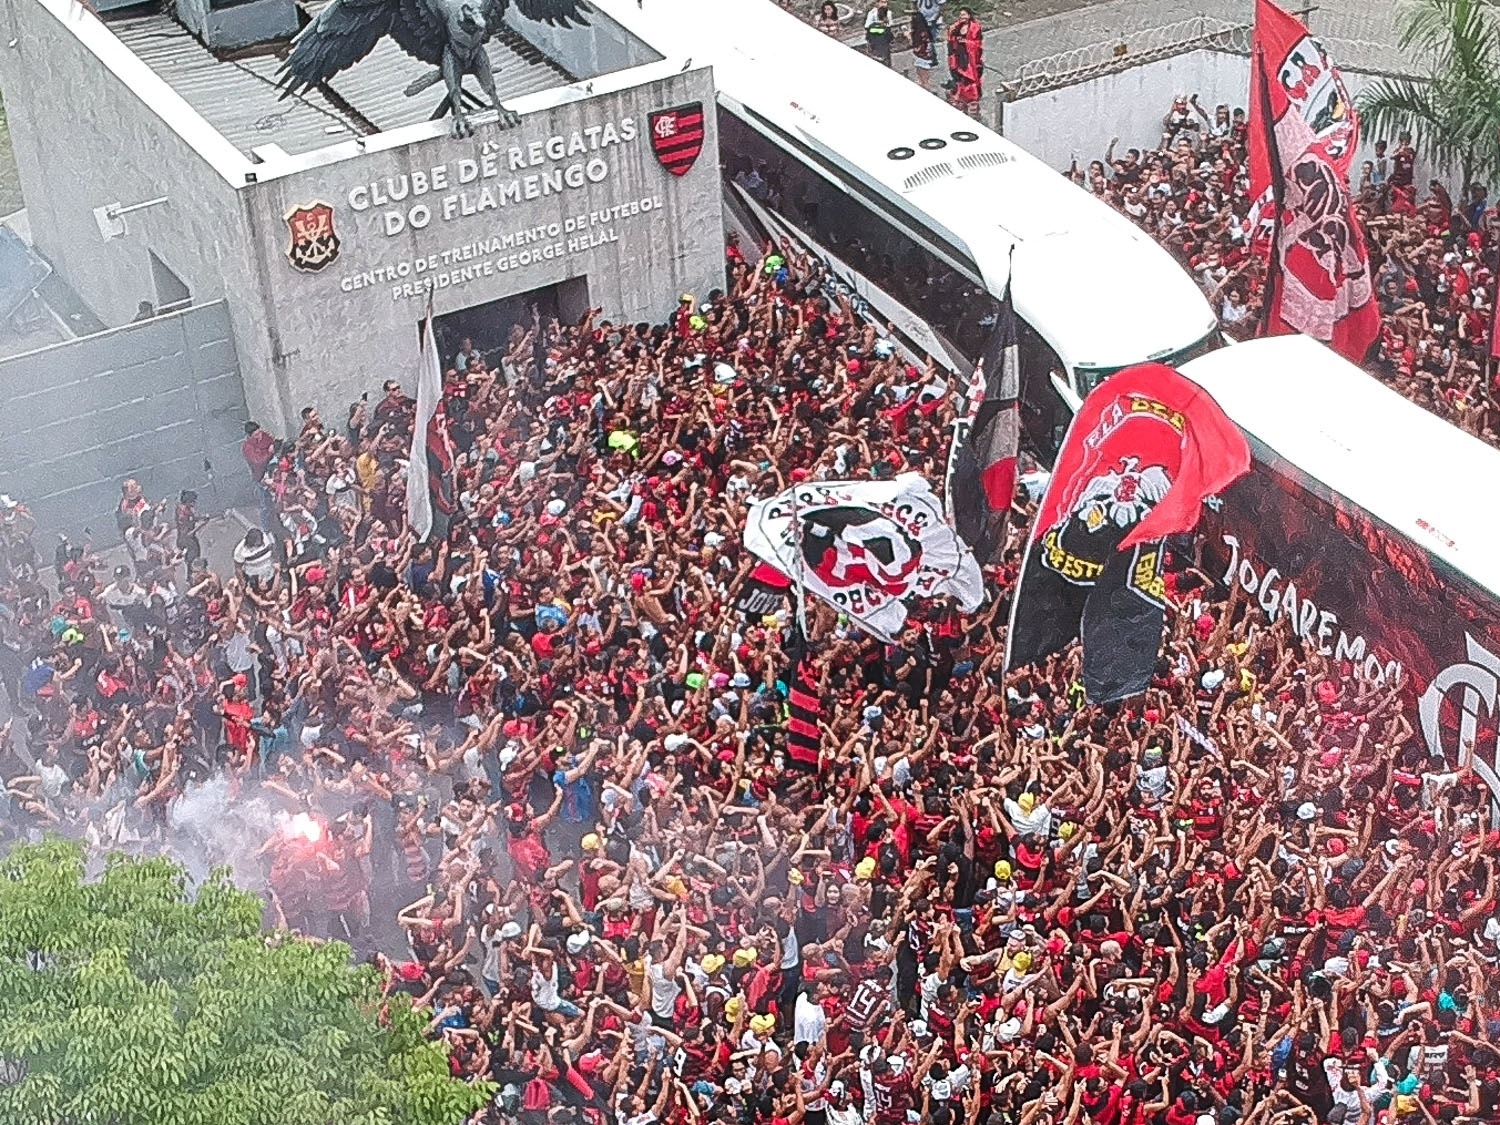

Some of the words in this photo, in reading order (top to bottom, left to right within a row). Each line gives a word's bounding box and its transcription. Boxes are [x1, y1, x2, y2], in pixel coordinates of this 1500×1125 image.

[348, 165, 448, 211] CLUBE
[508, 118, 637, 172] REGATAS
[384, 204, 431, 236] DO
[443, 159, 609, 220] FLAMENGO
[341, 261, 410, 293] CENTRO
[415, 251, 438, 273] DE
[440, 222, 560, 265] TREINAMENTO
[565, 214, 586, 234] DE
[589, 196, 662, 227] FUTEBOL
[392, 263, 494, 300] PRESIDENTE
[497, 242, 564, 272] GEORGE
[568, 228, 619, 254] HELAL
